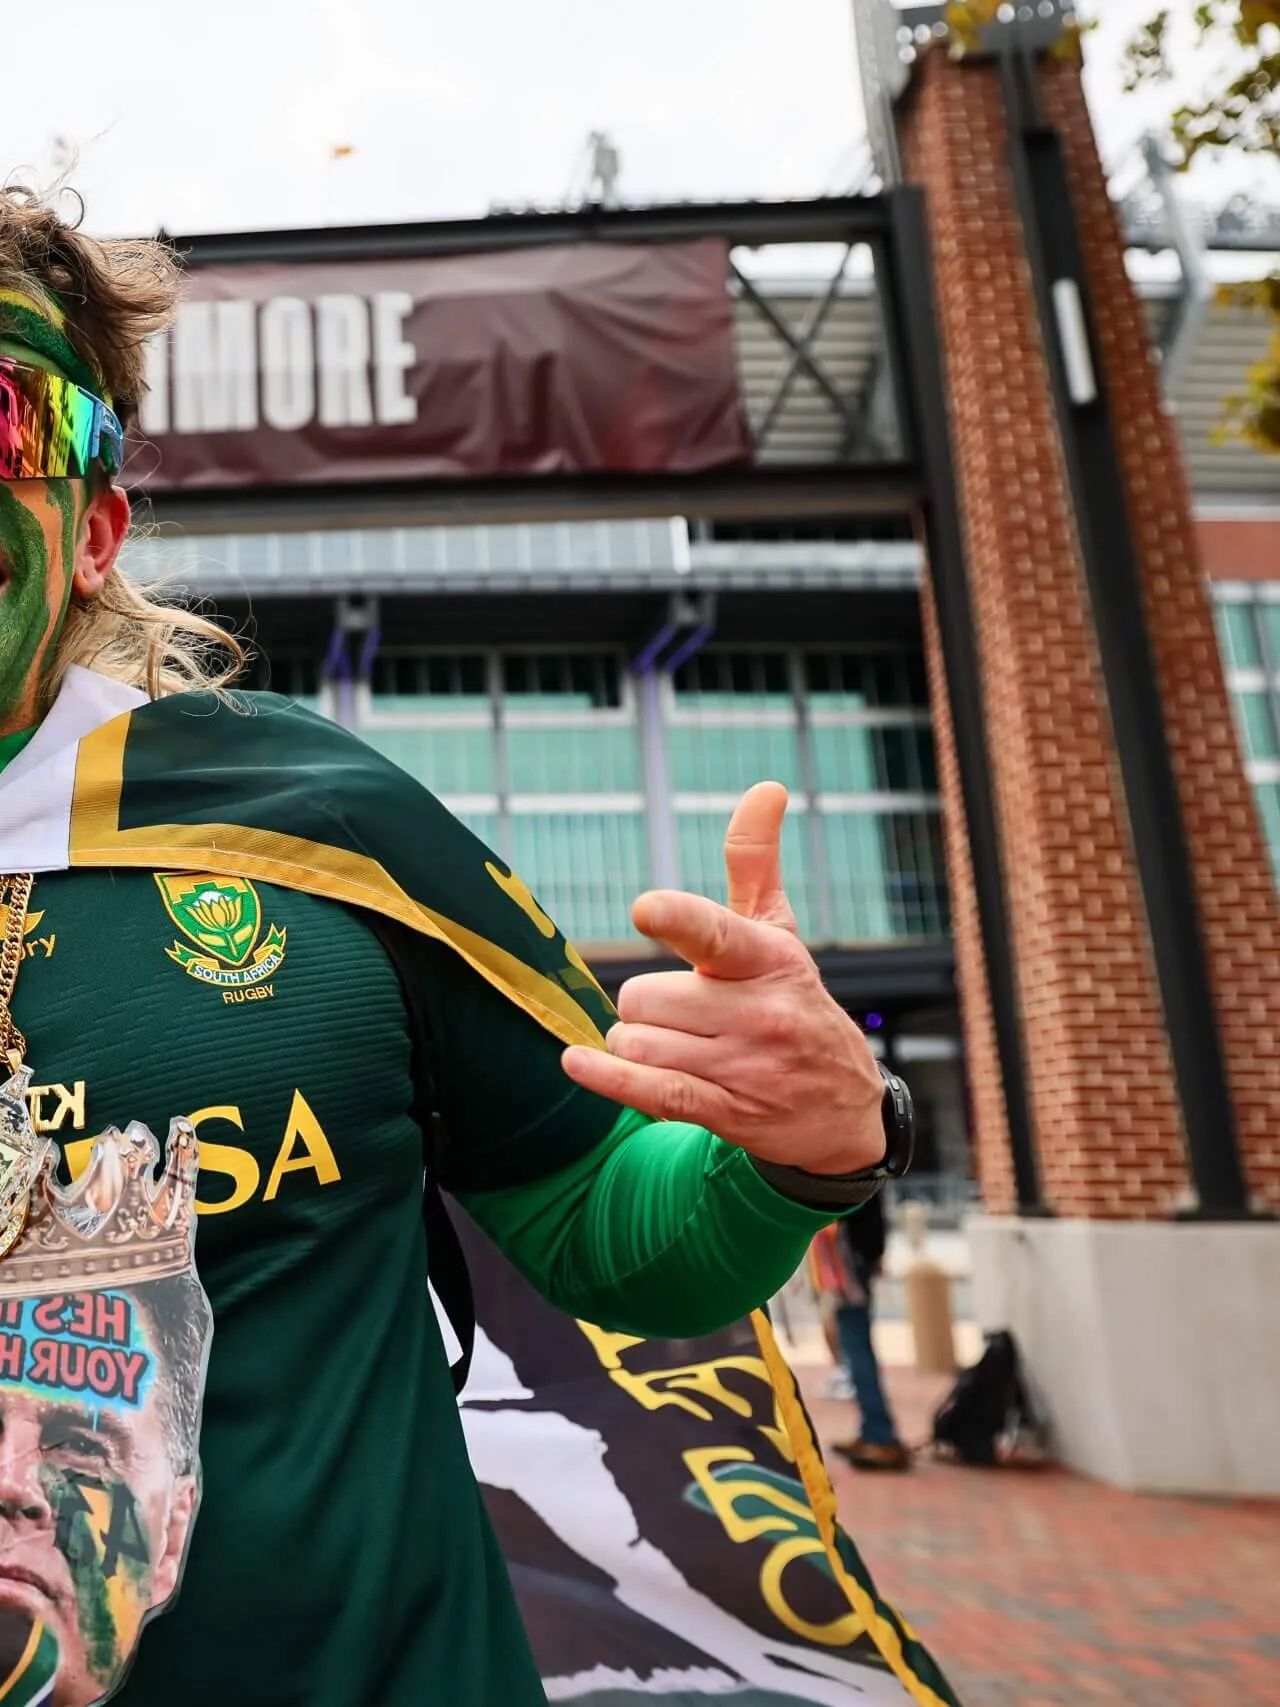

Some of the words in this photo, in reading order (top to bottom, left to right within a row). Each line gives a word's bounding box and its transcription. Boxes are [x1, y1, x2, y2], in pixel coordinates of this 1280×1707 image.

[194, 964, 240, 985] SOUTH
[243, 953, 282, 984] AFRICA
[222, 983, 275, 1005] RUGBY
